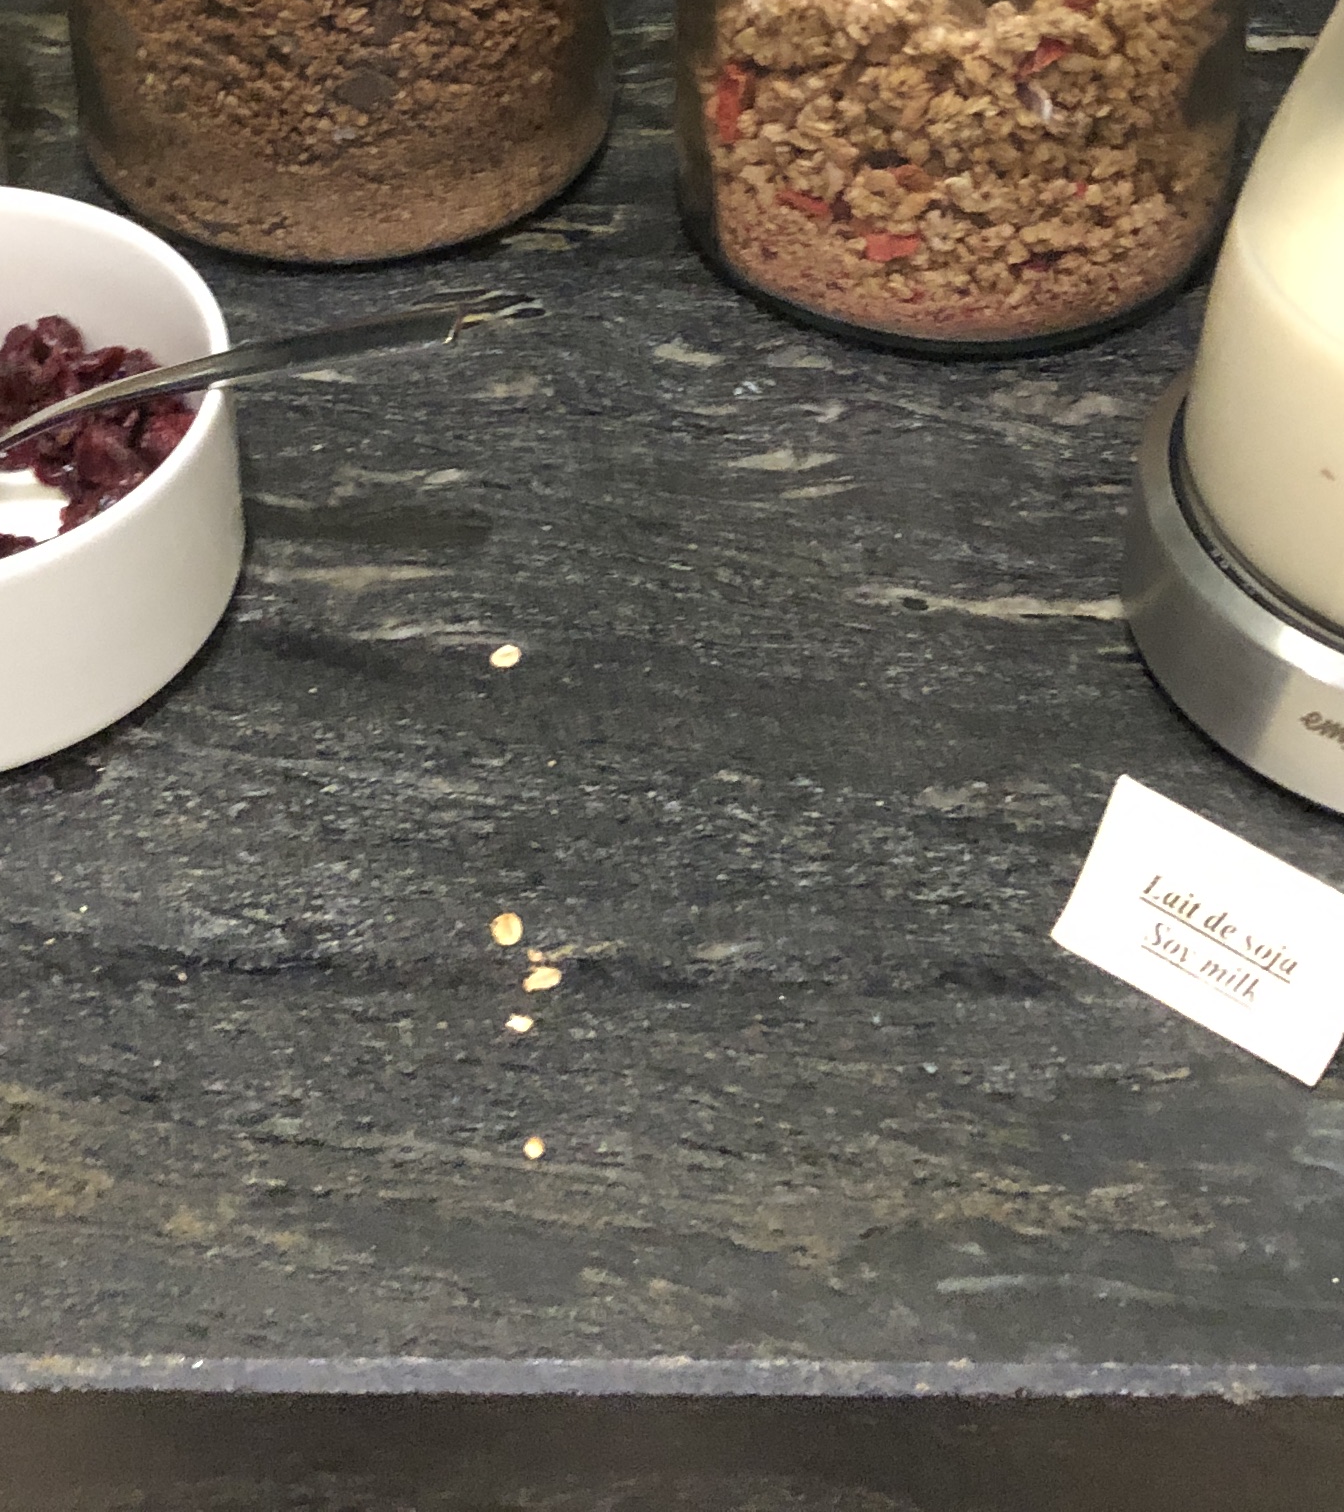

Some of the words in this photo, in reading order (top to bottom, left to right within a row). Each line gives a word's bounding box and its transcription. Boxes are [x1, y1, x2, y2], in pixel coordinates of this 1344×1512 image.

[1142, 874, 1202, 919] Lait
[1203, 912, 1238, 940] de
[1245, 935, 1298, 976] soja
[1199, 960, 1260, 1002] milk
